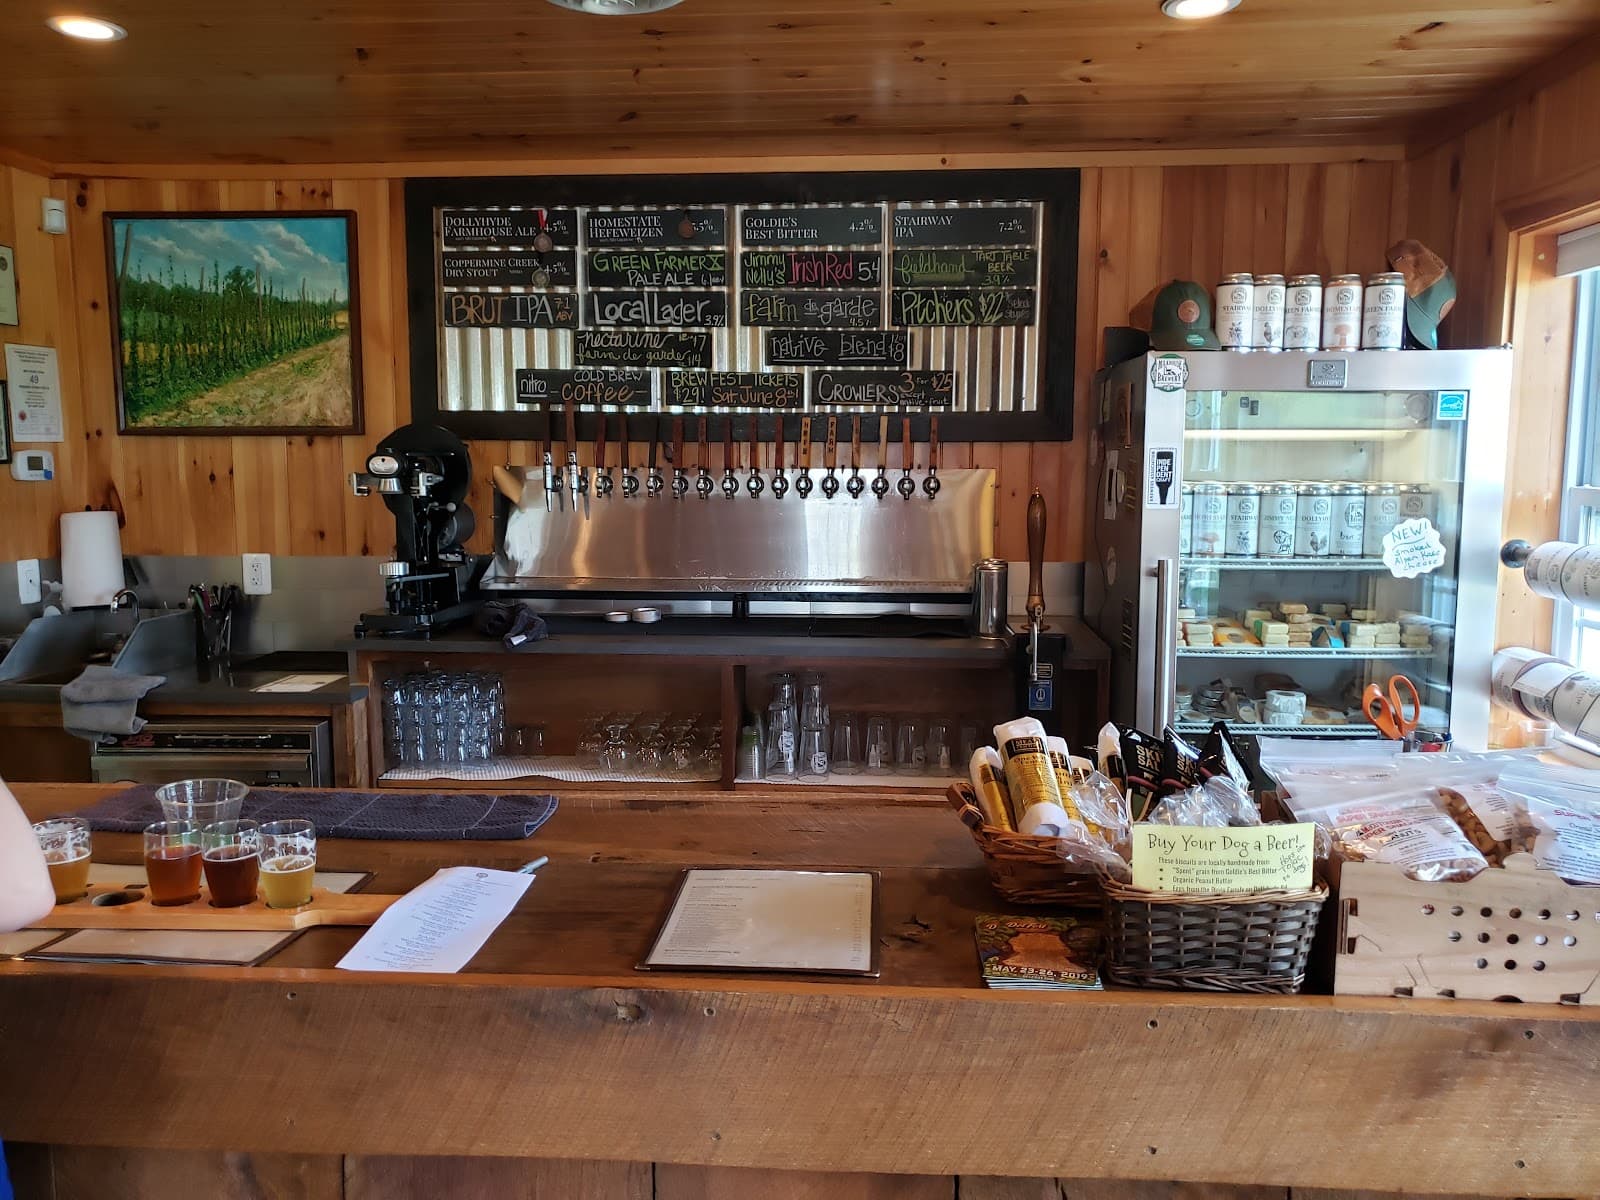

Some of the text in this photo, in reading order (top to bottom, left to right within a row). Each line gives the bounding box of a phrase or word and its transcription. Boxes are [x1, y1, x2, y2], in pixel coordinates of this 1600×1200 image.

[445, 217, 511, 227] DOLLYHYDE
[589, 216, 660, 228] HOMESTATE
[745, 217, 798, 228] GOLDIE'S
[849, 219, 874, 232] 4.2%
[895, 216, 953, 226] STAIRWAY
[999, 219, 1023, 232] 7.2%
[445, 226, 536, 237] FARMHOUSE ALE
[589, 228, 664, 238] HEFEWEIZEN
[745, 228, 819, 239] BEST BITTER
[895, 227, 914, 238] IPA
[444, 258, 540, 268] COPPERMINE CREEK
[593, 252, 651, 272] GREEN
[744, 253, 786, 273] Jimmy
[1001, 250, 1031, 263] TABLE
[445, 269, 464, 277] DRY
[467, 268, 499, 277] STOUT
[787, 252, 825, 287] Irish
[826, 252, 854, 286] Red
[988, 263, 1015, 273] BEER
[627, 269, 661, 286] PALE
[664, 273, 695, 286] ALE
[745, 268, 786, 286] Nelly's
[452, 295, 554, 325] BRUT IPA
[593, 291, 651, 325] Local
[654, 292, 711, 326] Lager
[818, 296, 878, 325] garde
[901, 290, 1004, 325] Pitchers $22
[771, 332, 887, 358] native blend
[576, 343, 619, 364] farm
[623, 348, 641, 360] de
[574, 370, 643, 382] COLD BREW
[671, 372, 799, 387] BREW FEST TICKETS
[899, 372, 915, 393] 3
[520, 373, 547, 394] nitro
[818, 374, 900, 404] CROWLERS
[739, 386, 773, 403] June
[1391, 521, 1427, 543] NEW!
[1147, 833, 1299, 858] Buy Your Dog a Beer!
[1175, 858, 1197, 866] biscuits
[1195, 868, 1210, 876] grain
[1225, 868, 1247, 876] Goldie's
[1172, 876, 1194, 885] Organic
[1061, 971, 1089, 980] 2019
